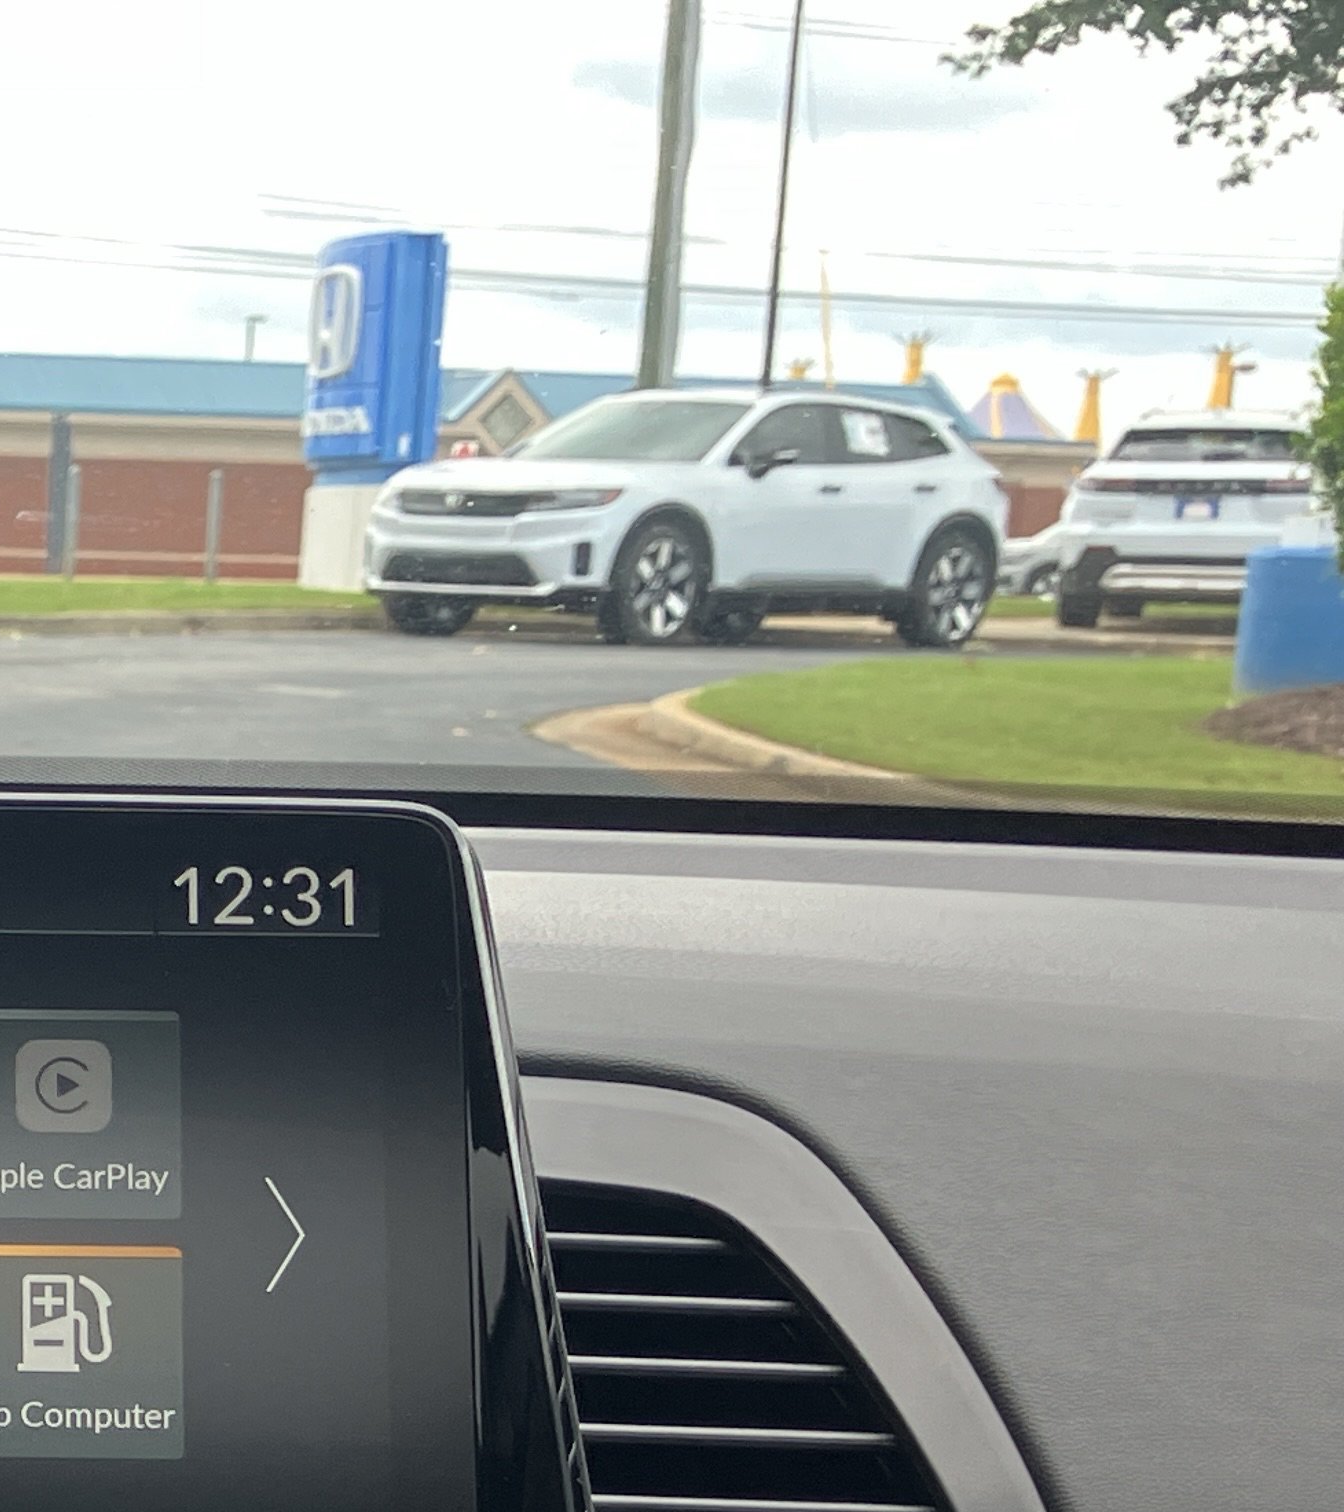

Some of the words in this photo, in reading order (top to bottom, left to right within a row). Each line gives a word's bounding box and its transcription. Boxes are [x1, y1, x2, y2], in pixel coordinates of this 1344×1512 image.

[173, 866, 355, 927] 12:31
[53, 1162, 169, 1196] CarPlay
[20, 1401, 176, 1434] Computer
